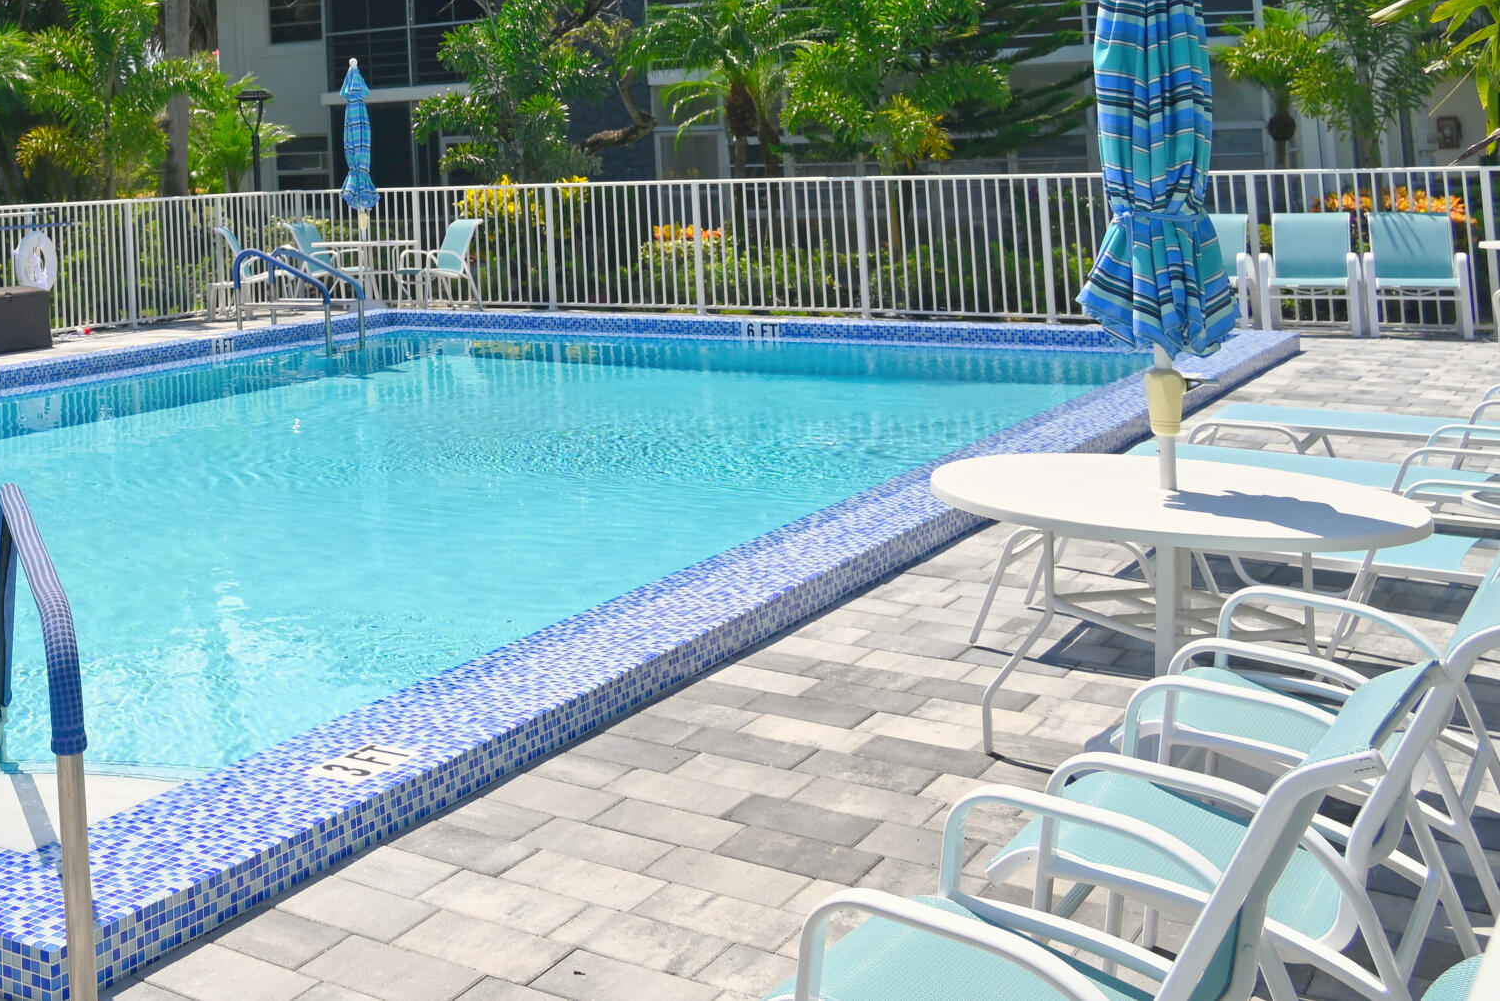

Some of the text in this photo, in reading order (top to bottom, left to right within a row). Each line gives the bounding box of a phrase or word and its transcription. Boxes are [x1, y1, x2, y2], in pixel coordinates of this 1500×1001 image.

[747, 323, 778, 337] 6 FT
[215, 338, 233, 354] 6 FT
[322, 744, 410, 777] 3 FT
